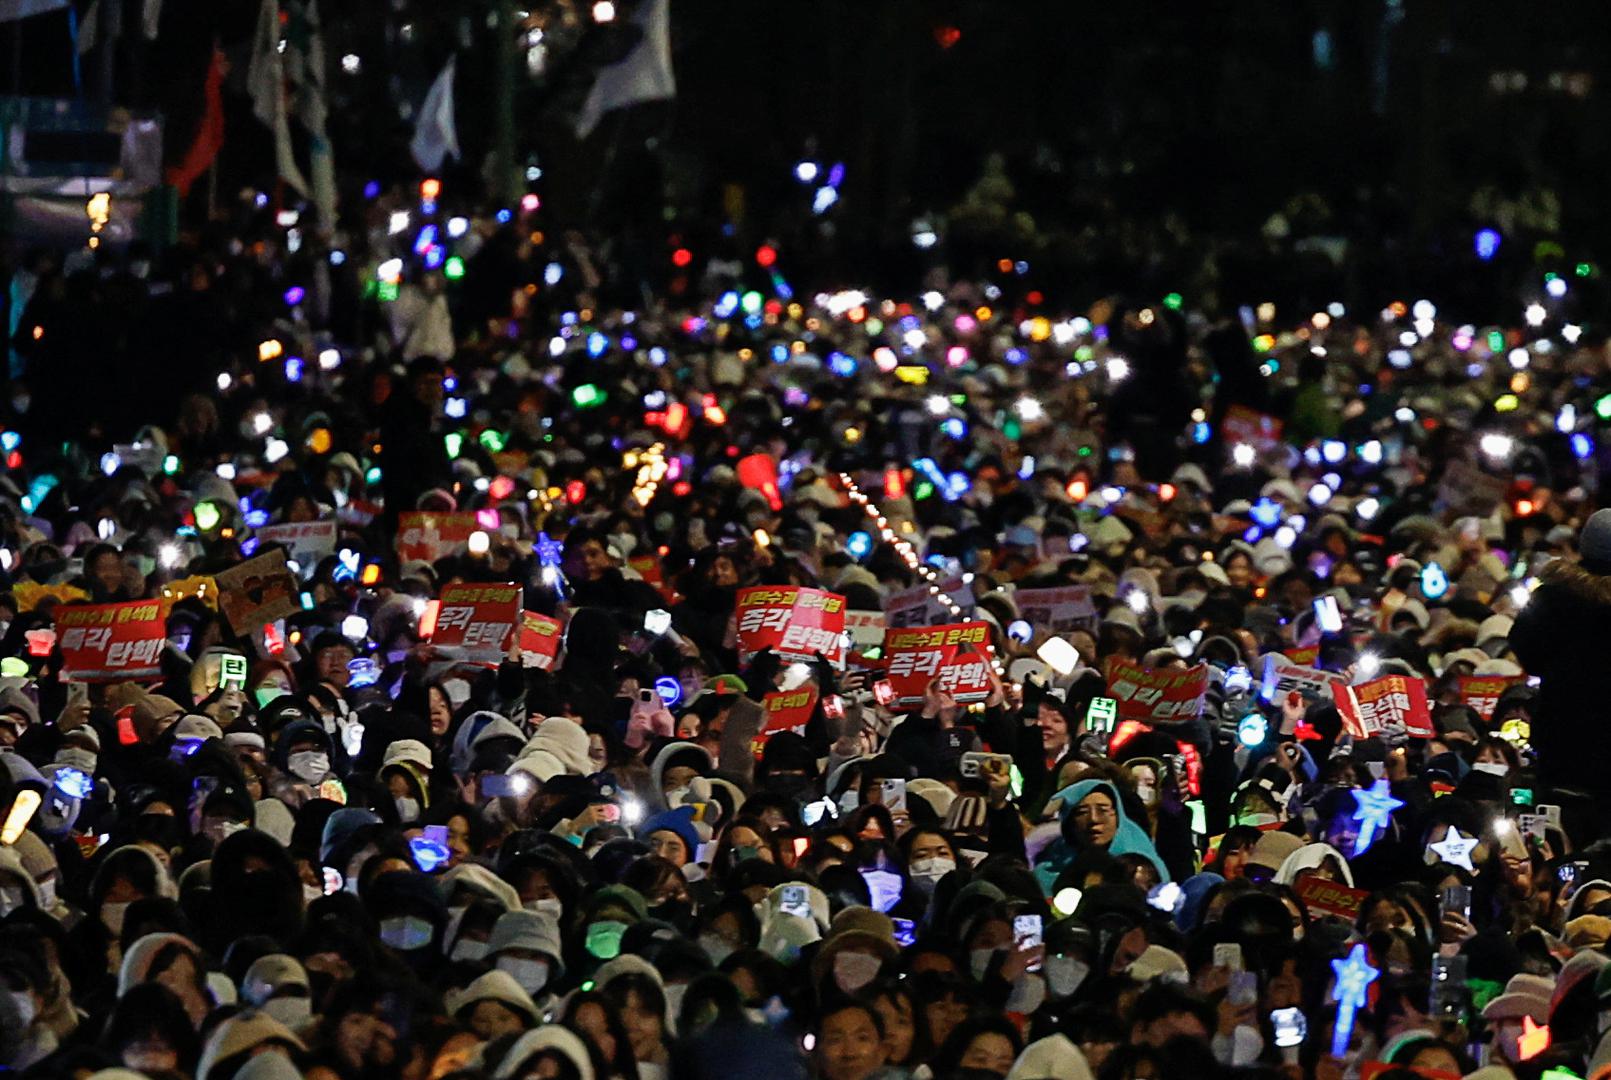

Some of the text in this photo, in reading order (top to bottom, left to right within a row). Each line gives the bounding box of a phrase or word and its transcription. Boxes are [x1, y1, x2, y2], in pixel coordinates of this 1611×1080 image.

[739, 591, 842, 613] 내란수괴 윤석열
[437, 606, 475, 631] 즉각
[740, 608, 792, 632] 즉각
[780, 624, 840, 656] 탄핵!
[888, 627, 986, 648] 내란수괴 윤석열
[105, 637, 165, 666] 탄핵!
[889, 650, 943, 677] 즉각
[226, 659, 243, 674] 탄
[939, 662, 988, 690] 탄핵!
